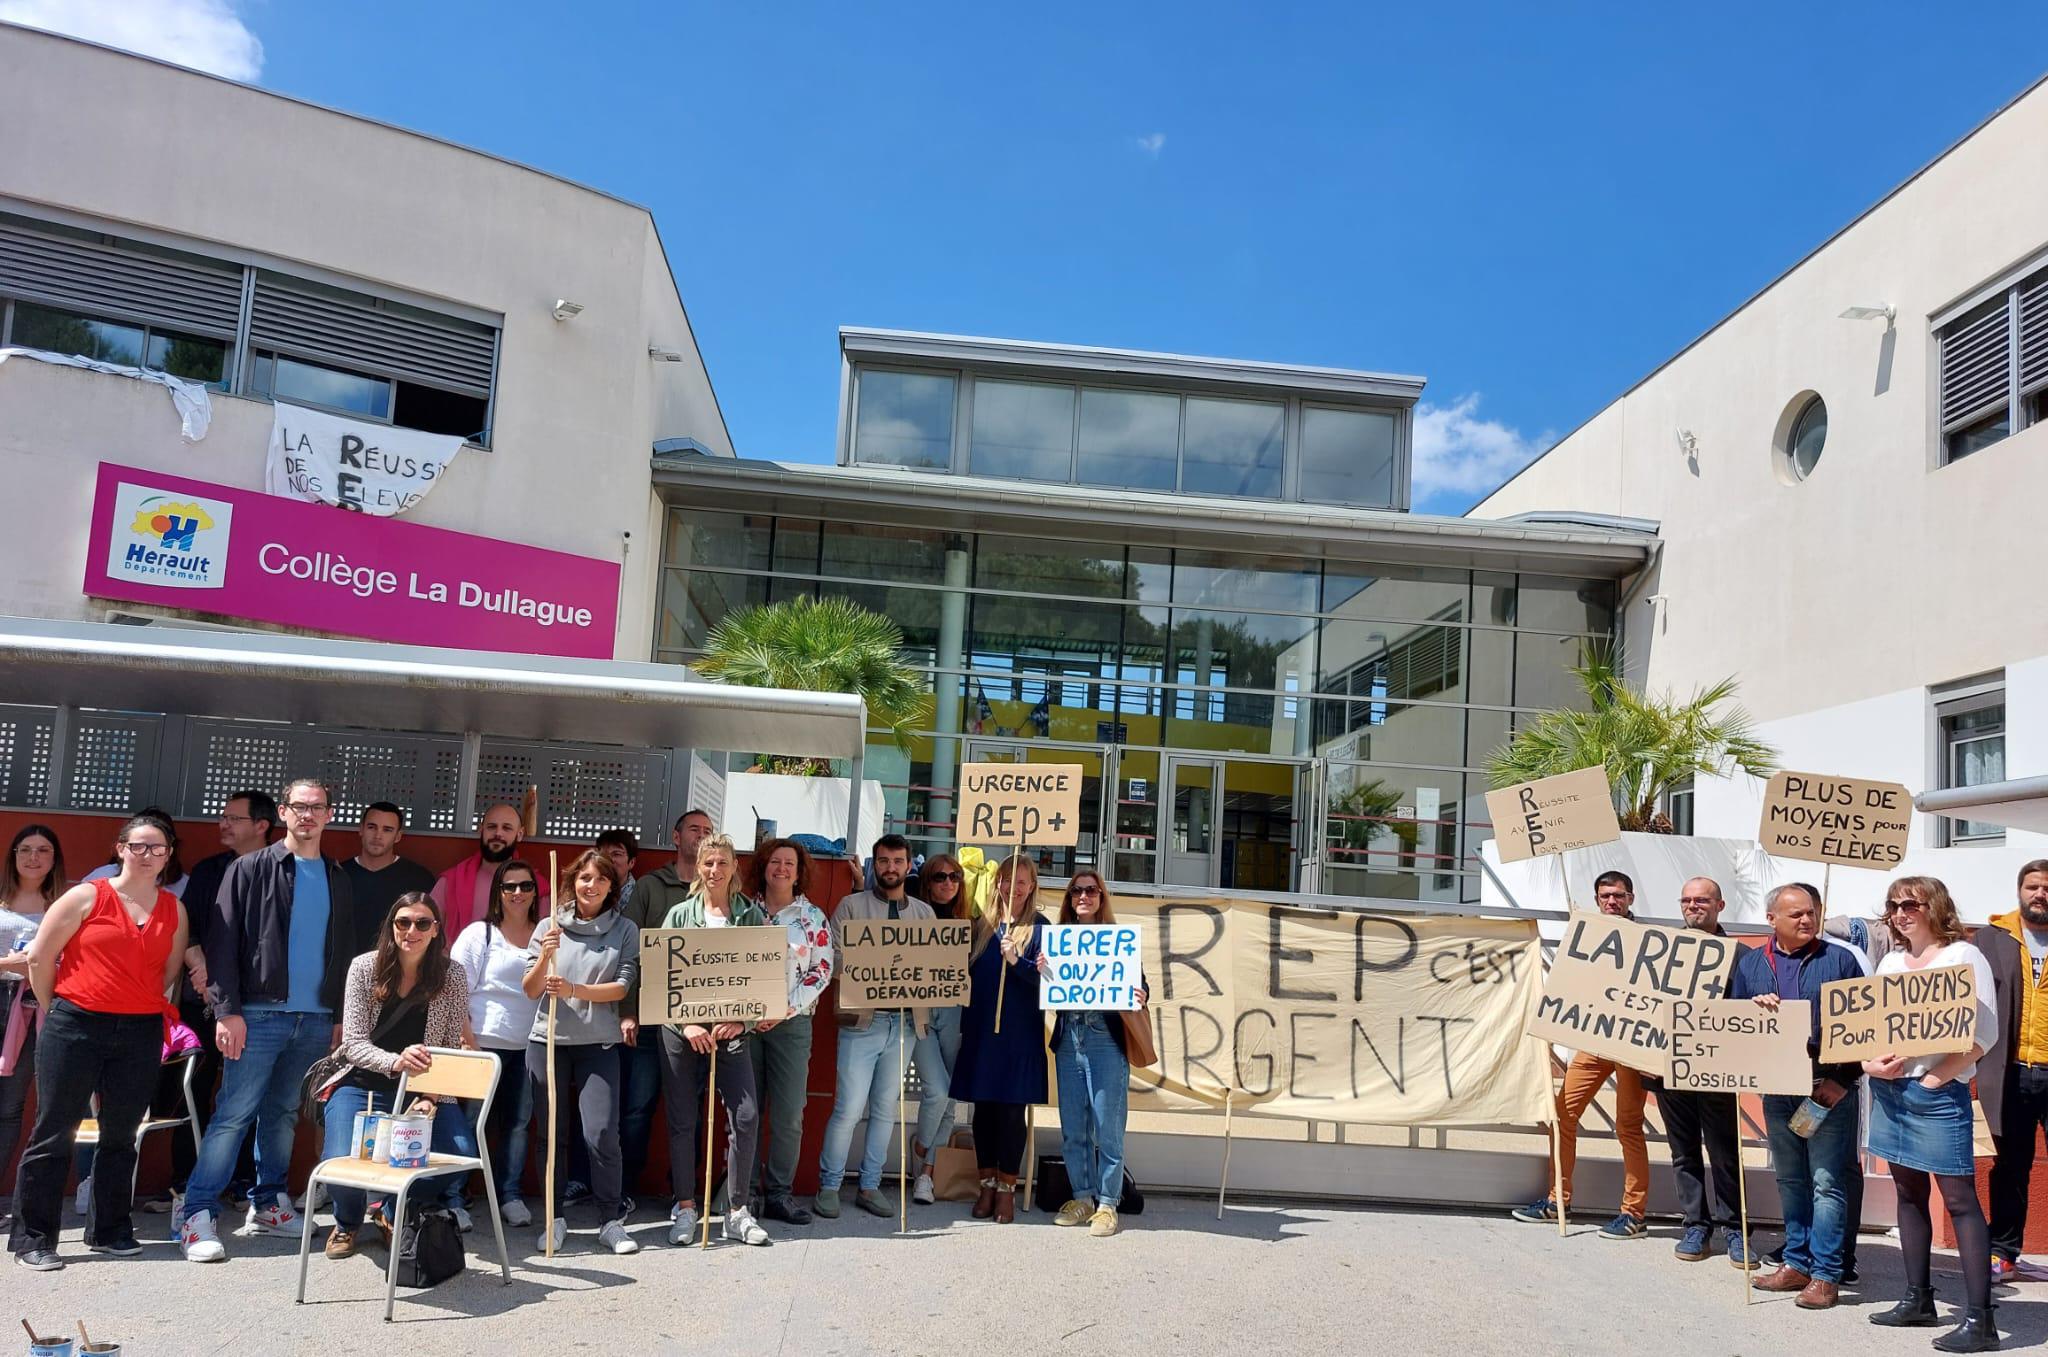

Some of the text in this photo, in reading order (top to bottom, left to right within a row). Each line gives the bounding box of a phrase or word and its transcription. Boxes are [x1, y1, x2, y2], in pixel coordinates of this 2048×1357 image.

[284, 428, 313, 454] LA
[286, 457, 307, 474] DE
[288, 475, 322, 492] NOS
[258, 542, 593, 627] Collège La Dullague
[968, 774, 1069, 793] URGENCE
[1784, 776, 1897, 810] PLUS DE
[1771, 804, 1865, 831] MOYENS
[1564, 840, 1585, 849] TOUS
[1776, 830, 1902, 863] NOS ÉLÈVES
[644, 935, 662, 949] LA
[745, 953, 759, 963] DE
[761, 952, 781, 962] NOS
[843, 925, 970, 947] LA DULLAGUE
[1048, 928, 1136, 957] LE REP+
[1158, 903, 1526, 1003] REP C'EST
[1567, 920, 1725, 999] LA REP+
[668, 969, 751, 991] ELEVES EST
[1059, 961, 1124, 981] ON Y A
[1604, 987, 1663, 1015] C'EST
[1829, 969, 1971, 1016] DES MOYENS
[1672, 1033, 1719, 1057] EST
[1829, 1023, 1876, 1049] POUR
